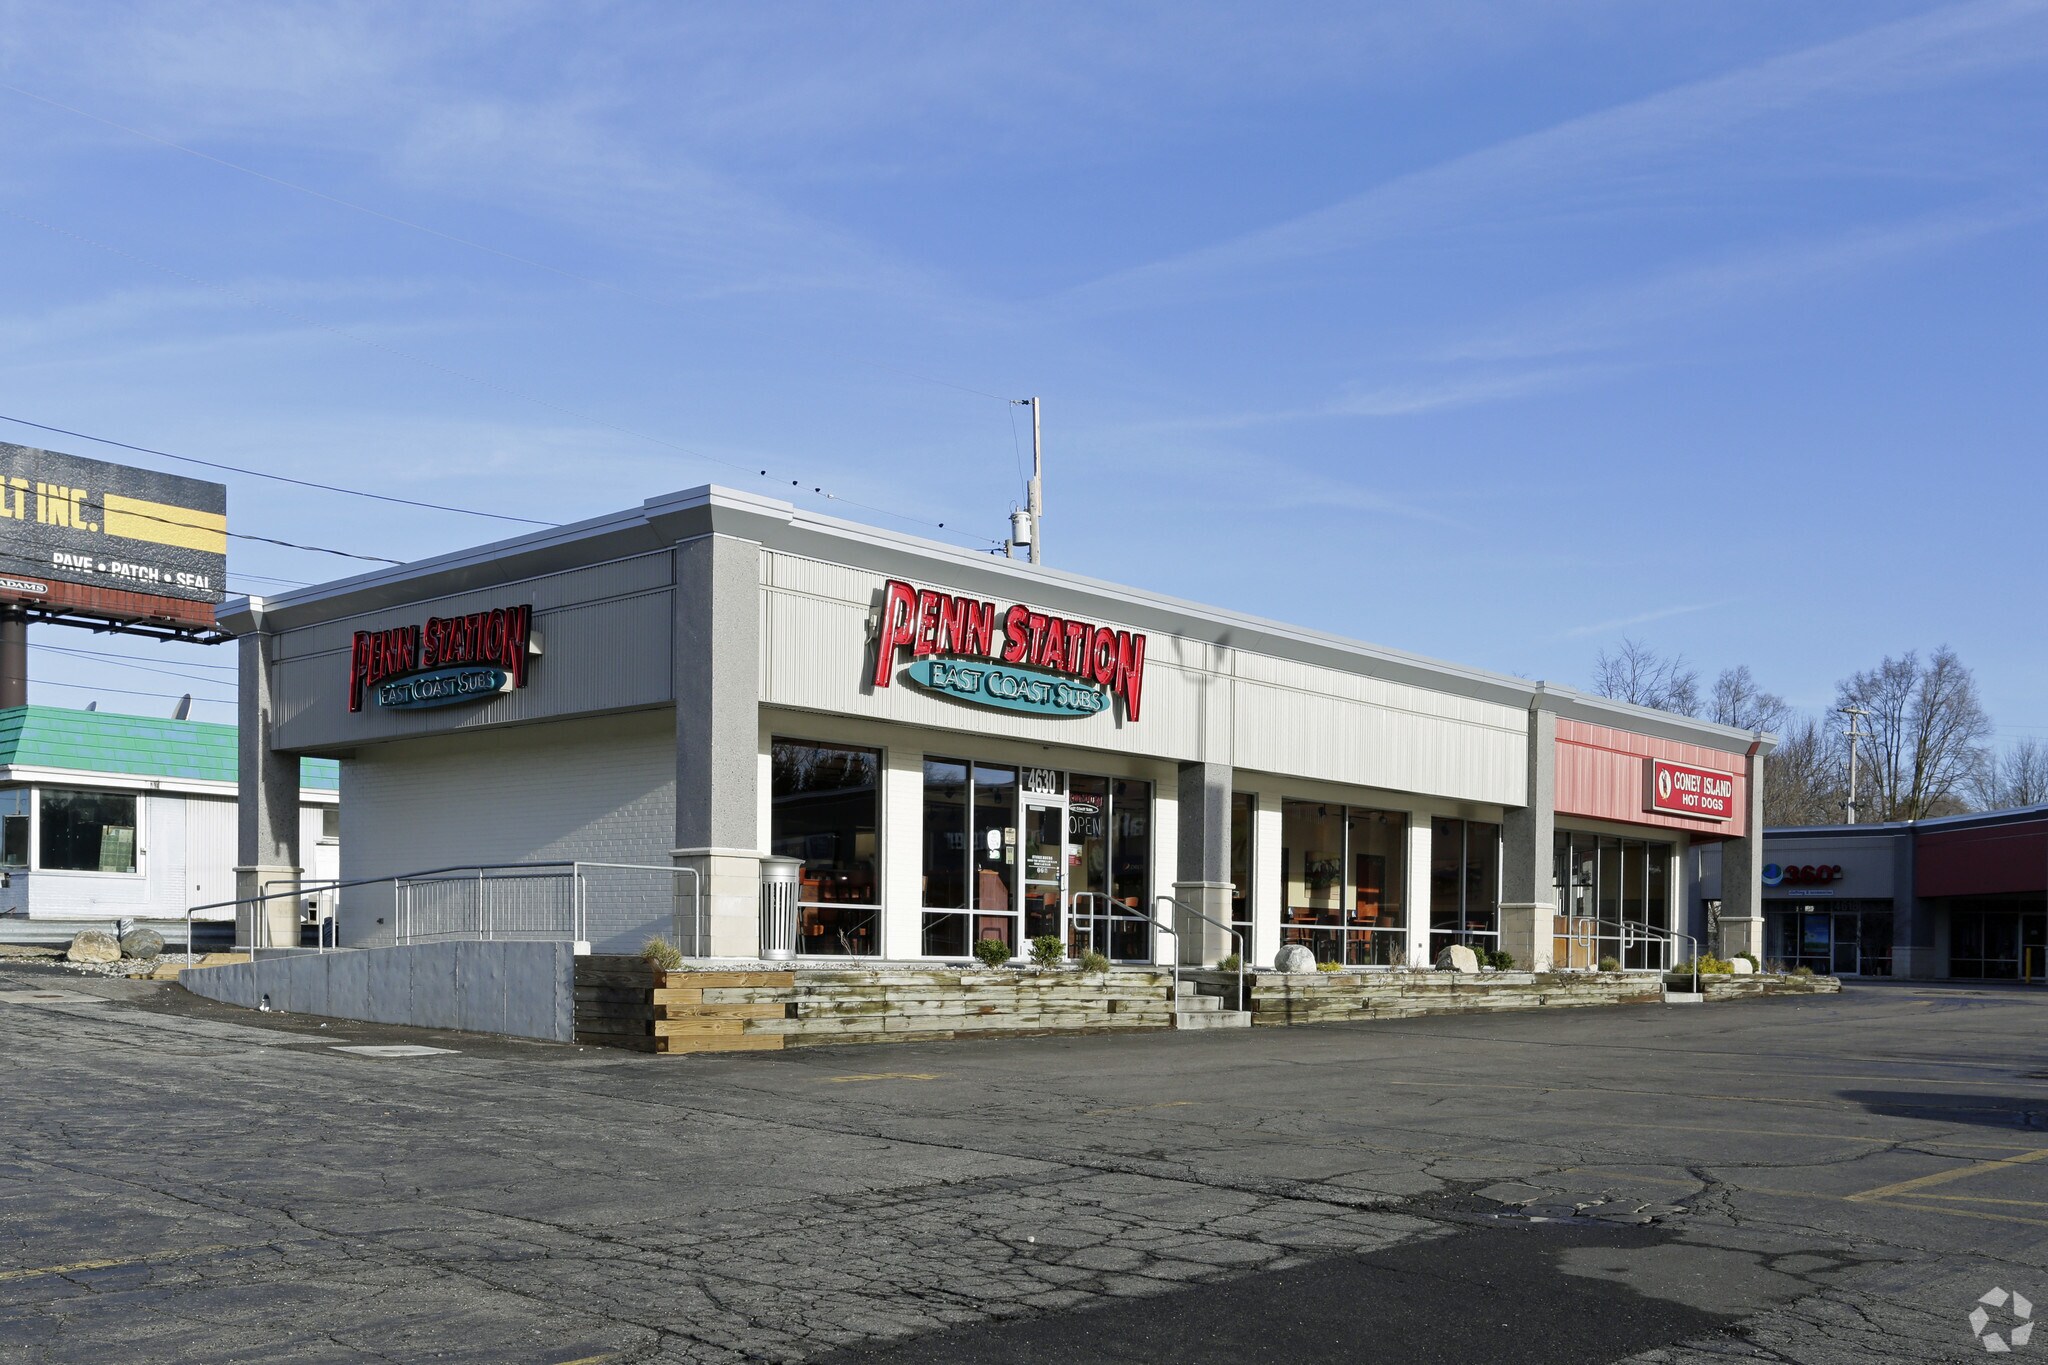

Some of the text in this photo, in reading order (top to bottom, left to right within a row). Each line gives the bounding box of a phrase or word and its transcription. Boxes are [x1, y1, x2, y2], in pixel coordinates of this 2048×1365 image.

[37, 482, 99, 532] INC.
[0, 580, 44, 592] ADAMS
[53, 553, 213, 593] PAVE PATCH SEAL
[350, 604, 532, 713] PENN STATION
[873, 579, 1146, 722] PENN STATION
[379, 670, 495, 706] EAST COAST SUBS
[930, 663, 1102, 713] EAST COAST SUBS
[1027, 769, 1056, 795] 4630
[1674, 772, 1732, 797] CONEY ISLAND
[1682, 793, 1724, 811] HOT DOGS
[1069, 815, 1101, 836] OPEN
